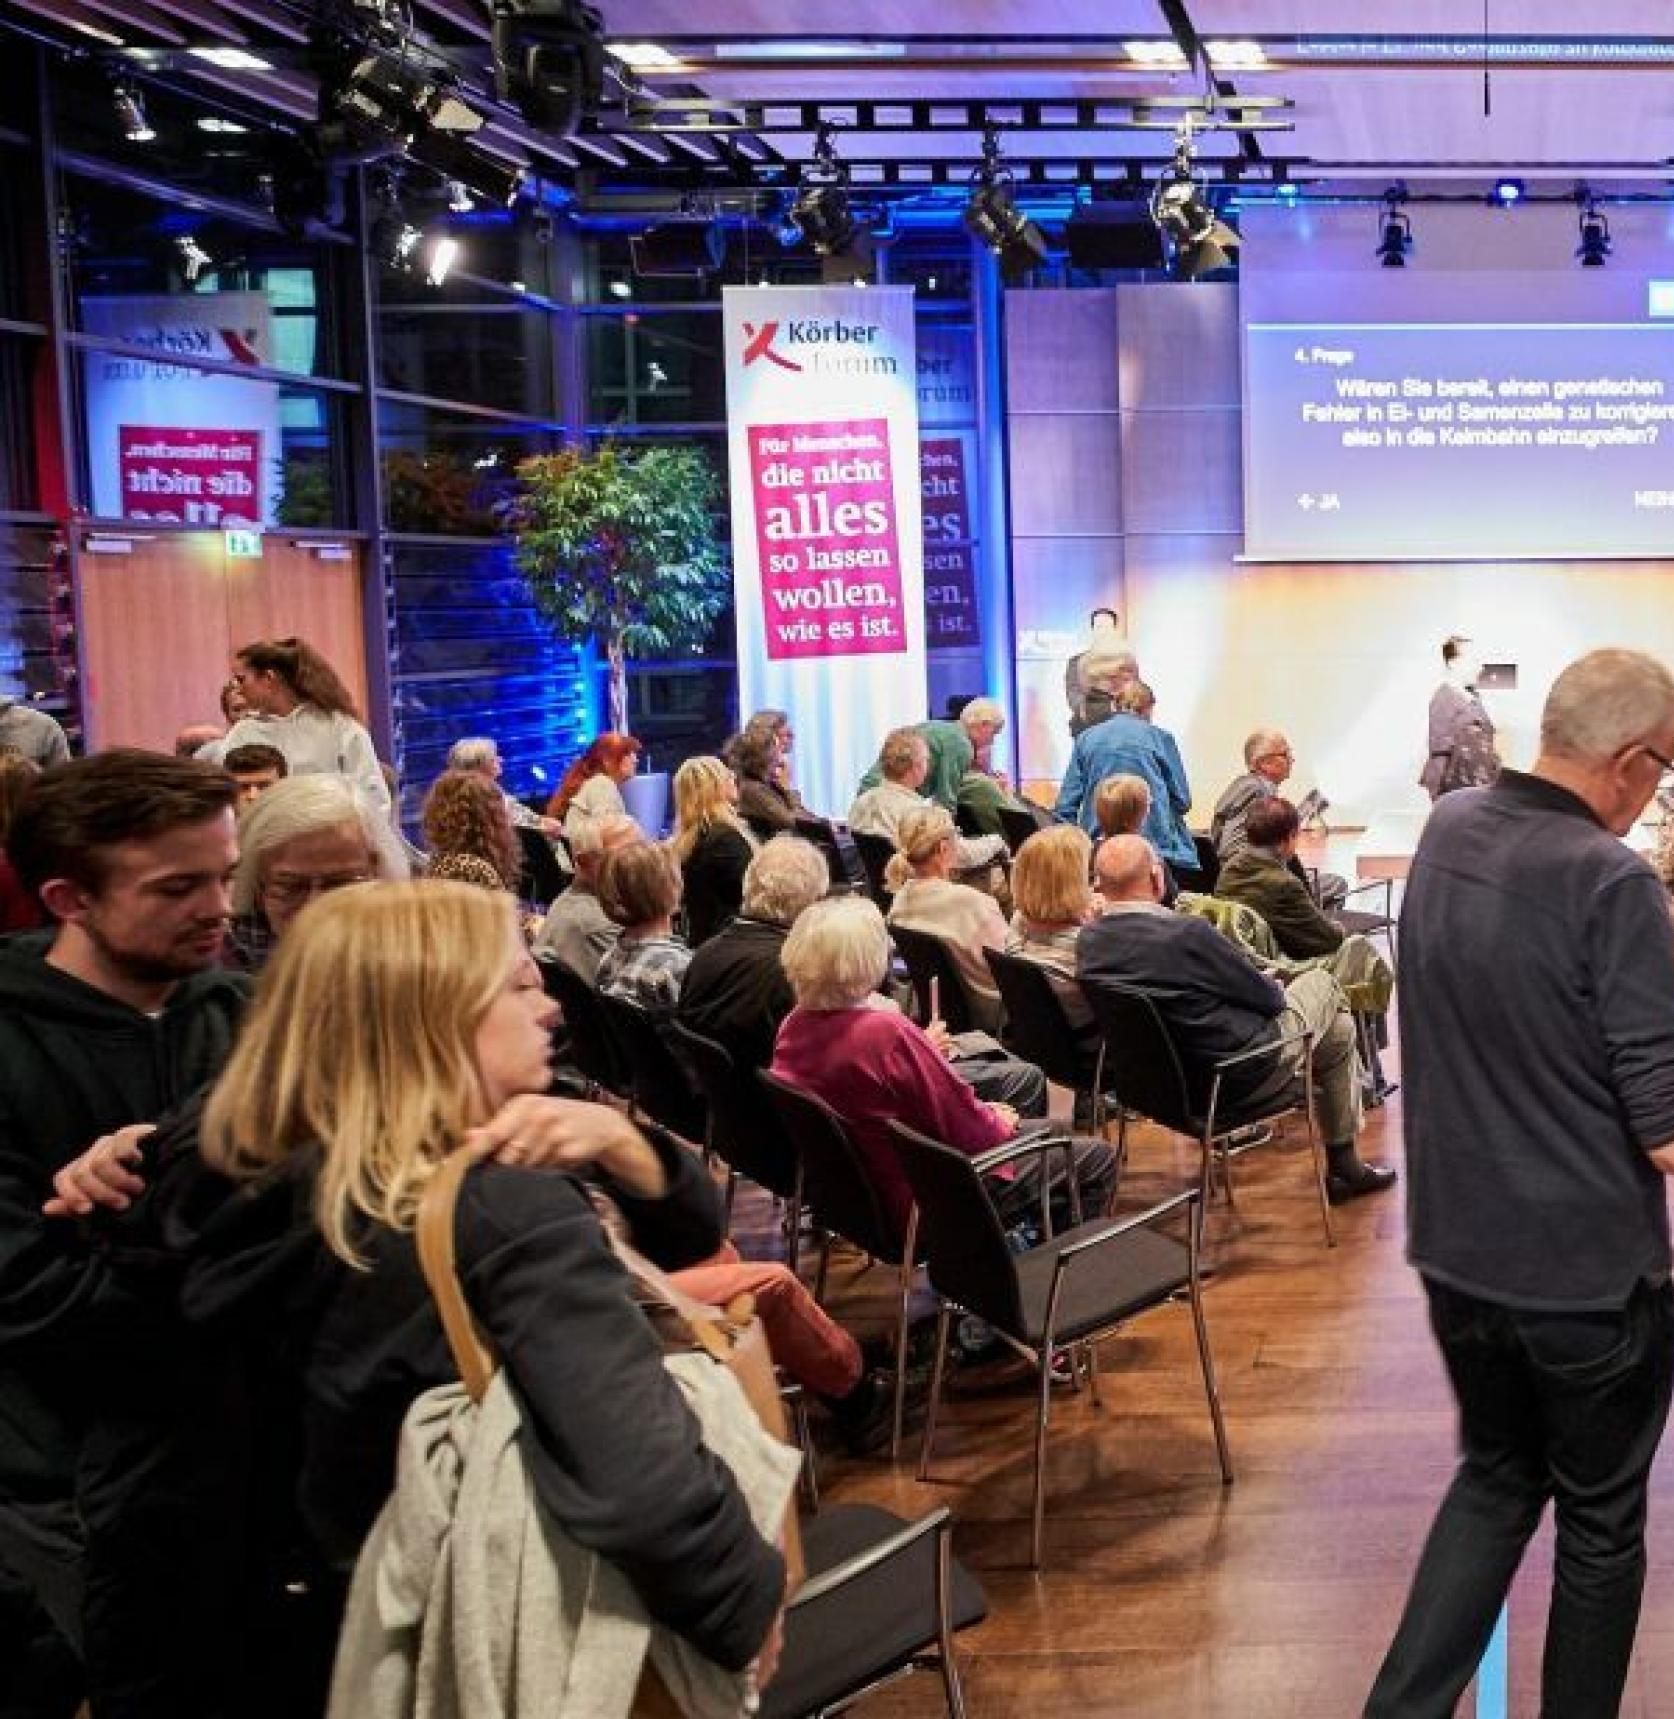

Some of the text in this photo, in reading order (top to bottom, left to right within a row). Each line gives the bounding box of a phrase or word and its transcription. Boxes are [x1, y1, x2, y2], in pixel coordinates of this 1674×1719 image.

[788, 320, 879, 344] Körber
[1403, 377, 1433, 397] Sie
[1418, 402, 1453, 422] und
[1568, 406, 1592, 422] zu
[1406, 427, 1435, 446] die
[761, 457, 886, 488] die nicht
[765, 491, 889, 542] alles
[769, 546, 890, 573] so lassen
[772, 577, 897, 612] wollen,
[777, 615, 898, 643] wie es ist.
